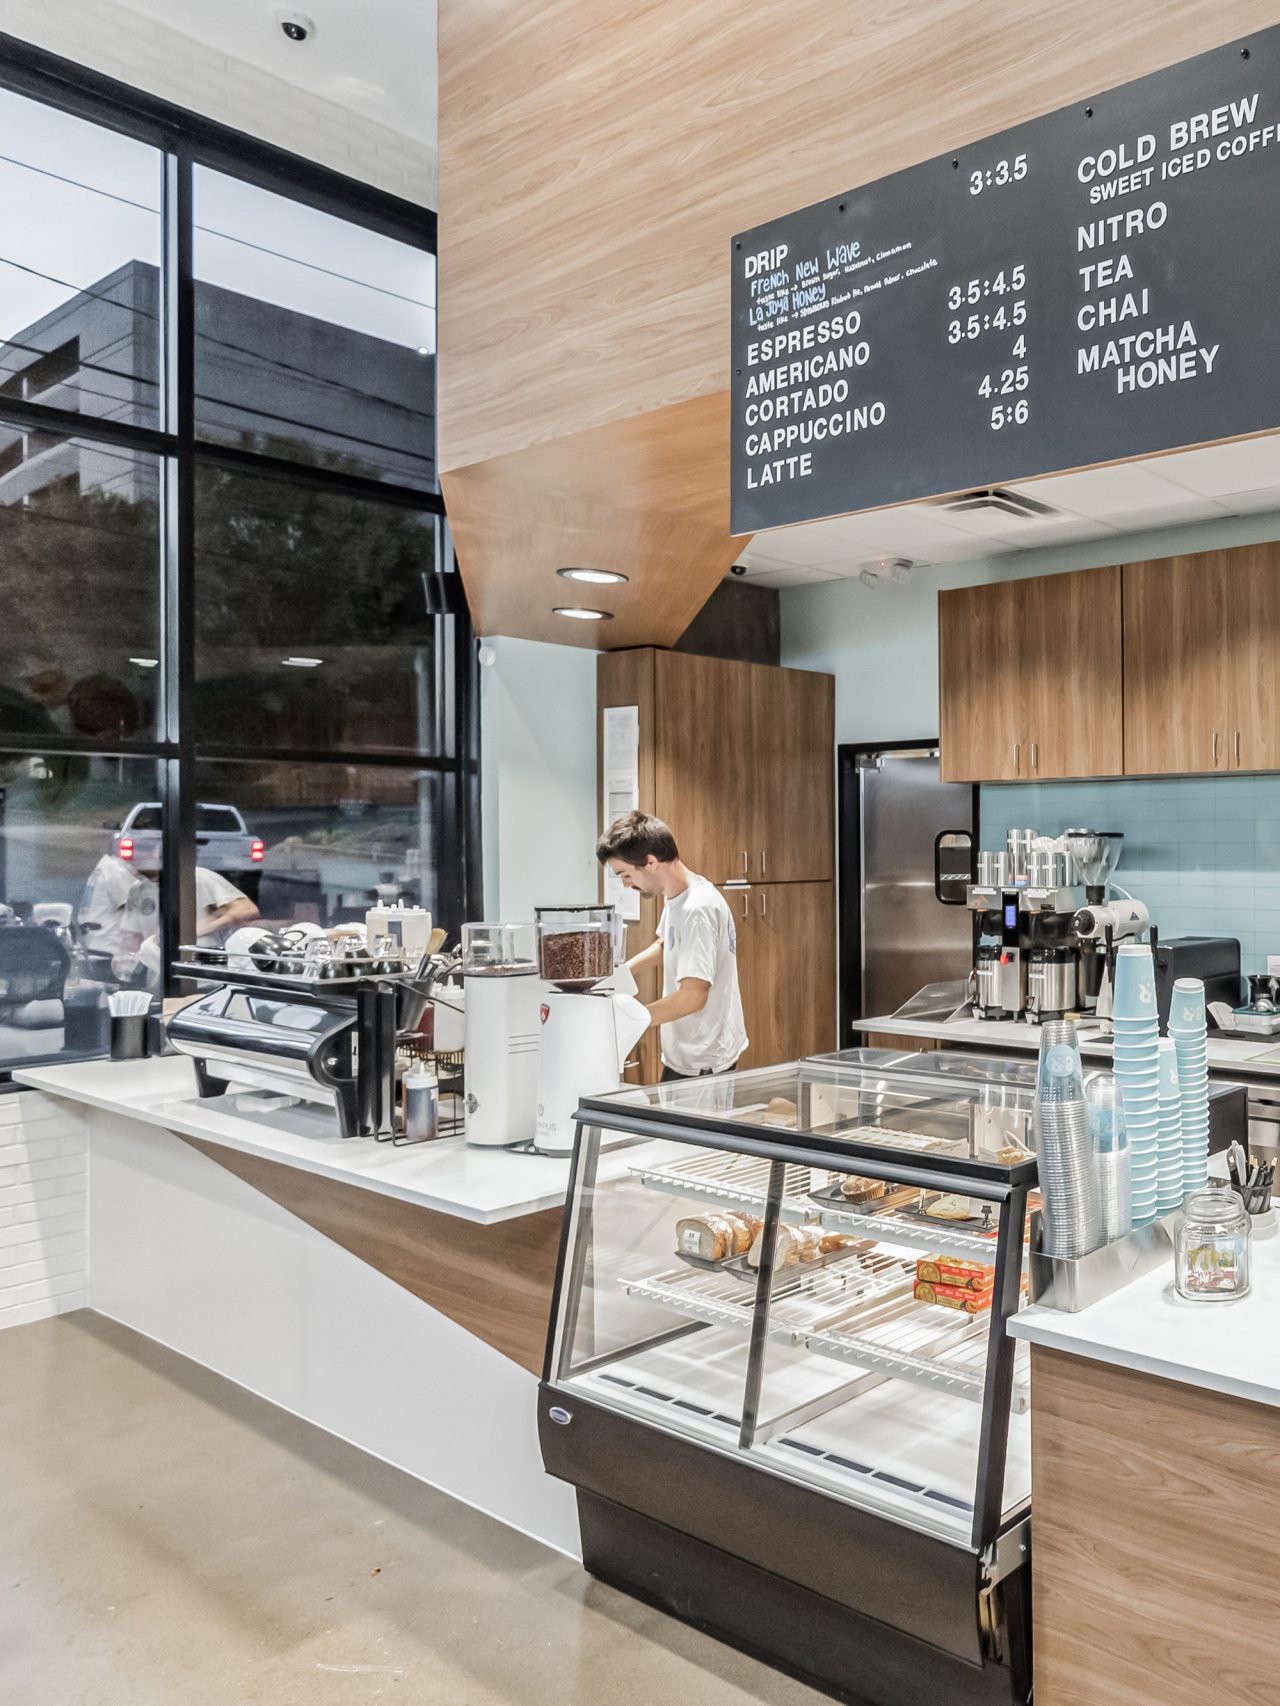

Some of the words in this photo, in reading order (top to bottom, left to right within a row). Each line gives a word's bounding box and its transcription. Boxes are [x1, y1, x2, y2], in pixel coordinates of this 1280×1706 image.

[1077, 133, 1157, 183] COLD
[1170, 94, 1259, 151] BREW
[969, 154, 1028, 196] 3:3.5
[1089, 166, 1154, 204] SWEET
[1162, 148, 1211, 180] ICED
[1077, 201, 1168, 251] NITRO
[744, 244, 788, 279] DRIP
[827, 241, 861, 270] Wave
[1079, 254, 1134, 292] TEA
[948, 265, 1026, 310] 3.5:4.5
[1077, 288, 1149, 331] CHAI
[747, 311, 861, 366] ESPRESSO
[749, 308, 763, 326] La
[948, 300, 1027, 344] 3.5:4.5
[1012, 335, 1026, 359] 4
[1077, 320, 1197, 374] MATCHA
[1116, 344, 1220, 393] HONEY
[745, 341, 871, 398] AMERICANO
[978, 366, 1029, 399] 4.25
[745, 379, 849, 426] CORTADO
[990, 400, 1029, 430] 5:6
[746, 401, 886, 456] CAPPUCCINO
[747, 453, 812, 489] LATTE
